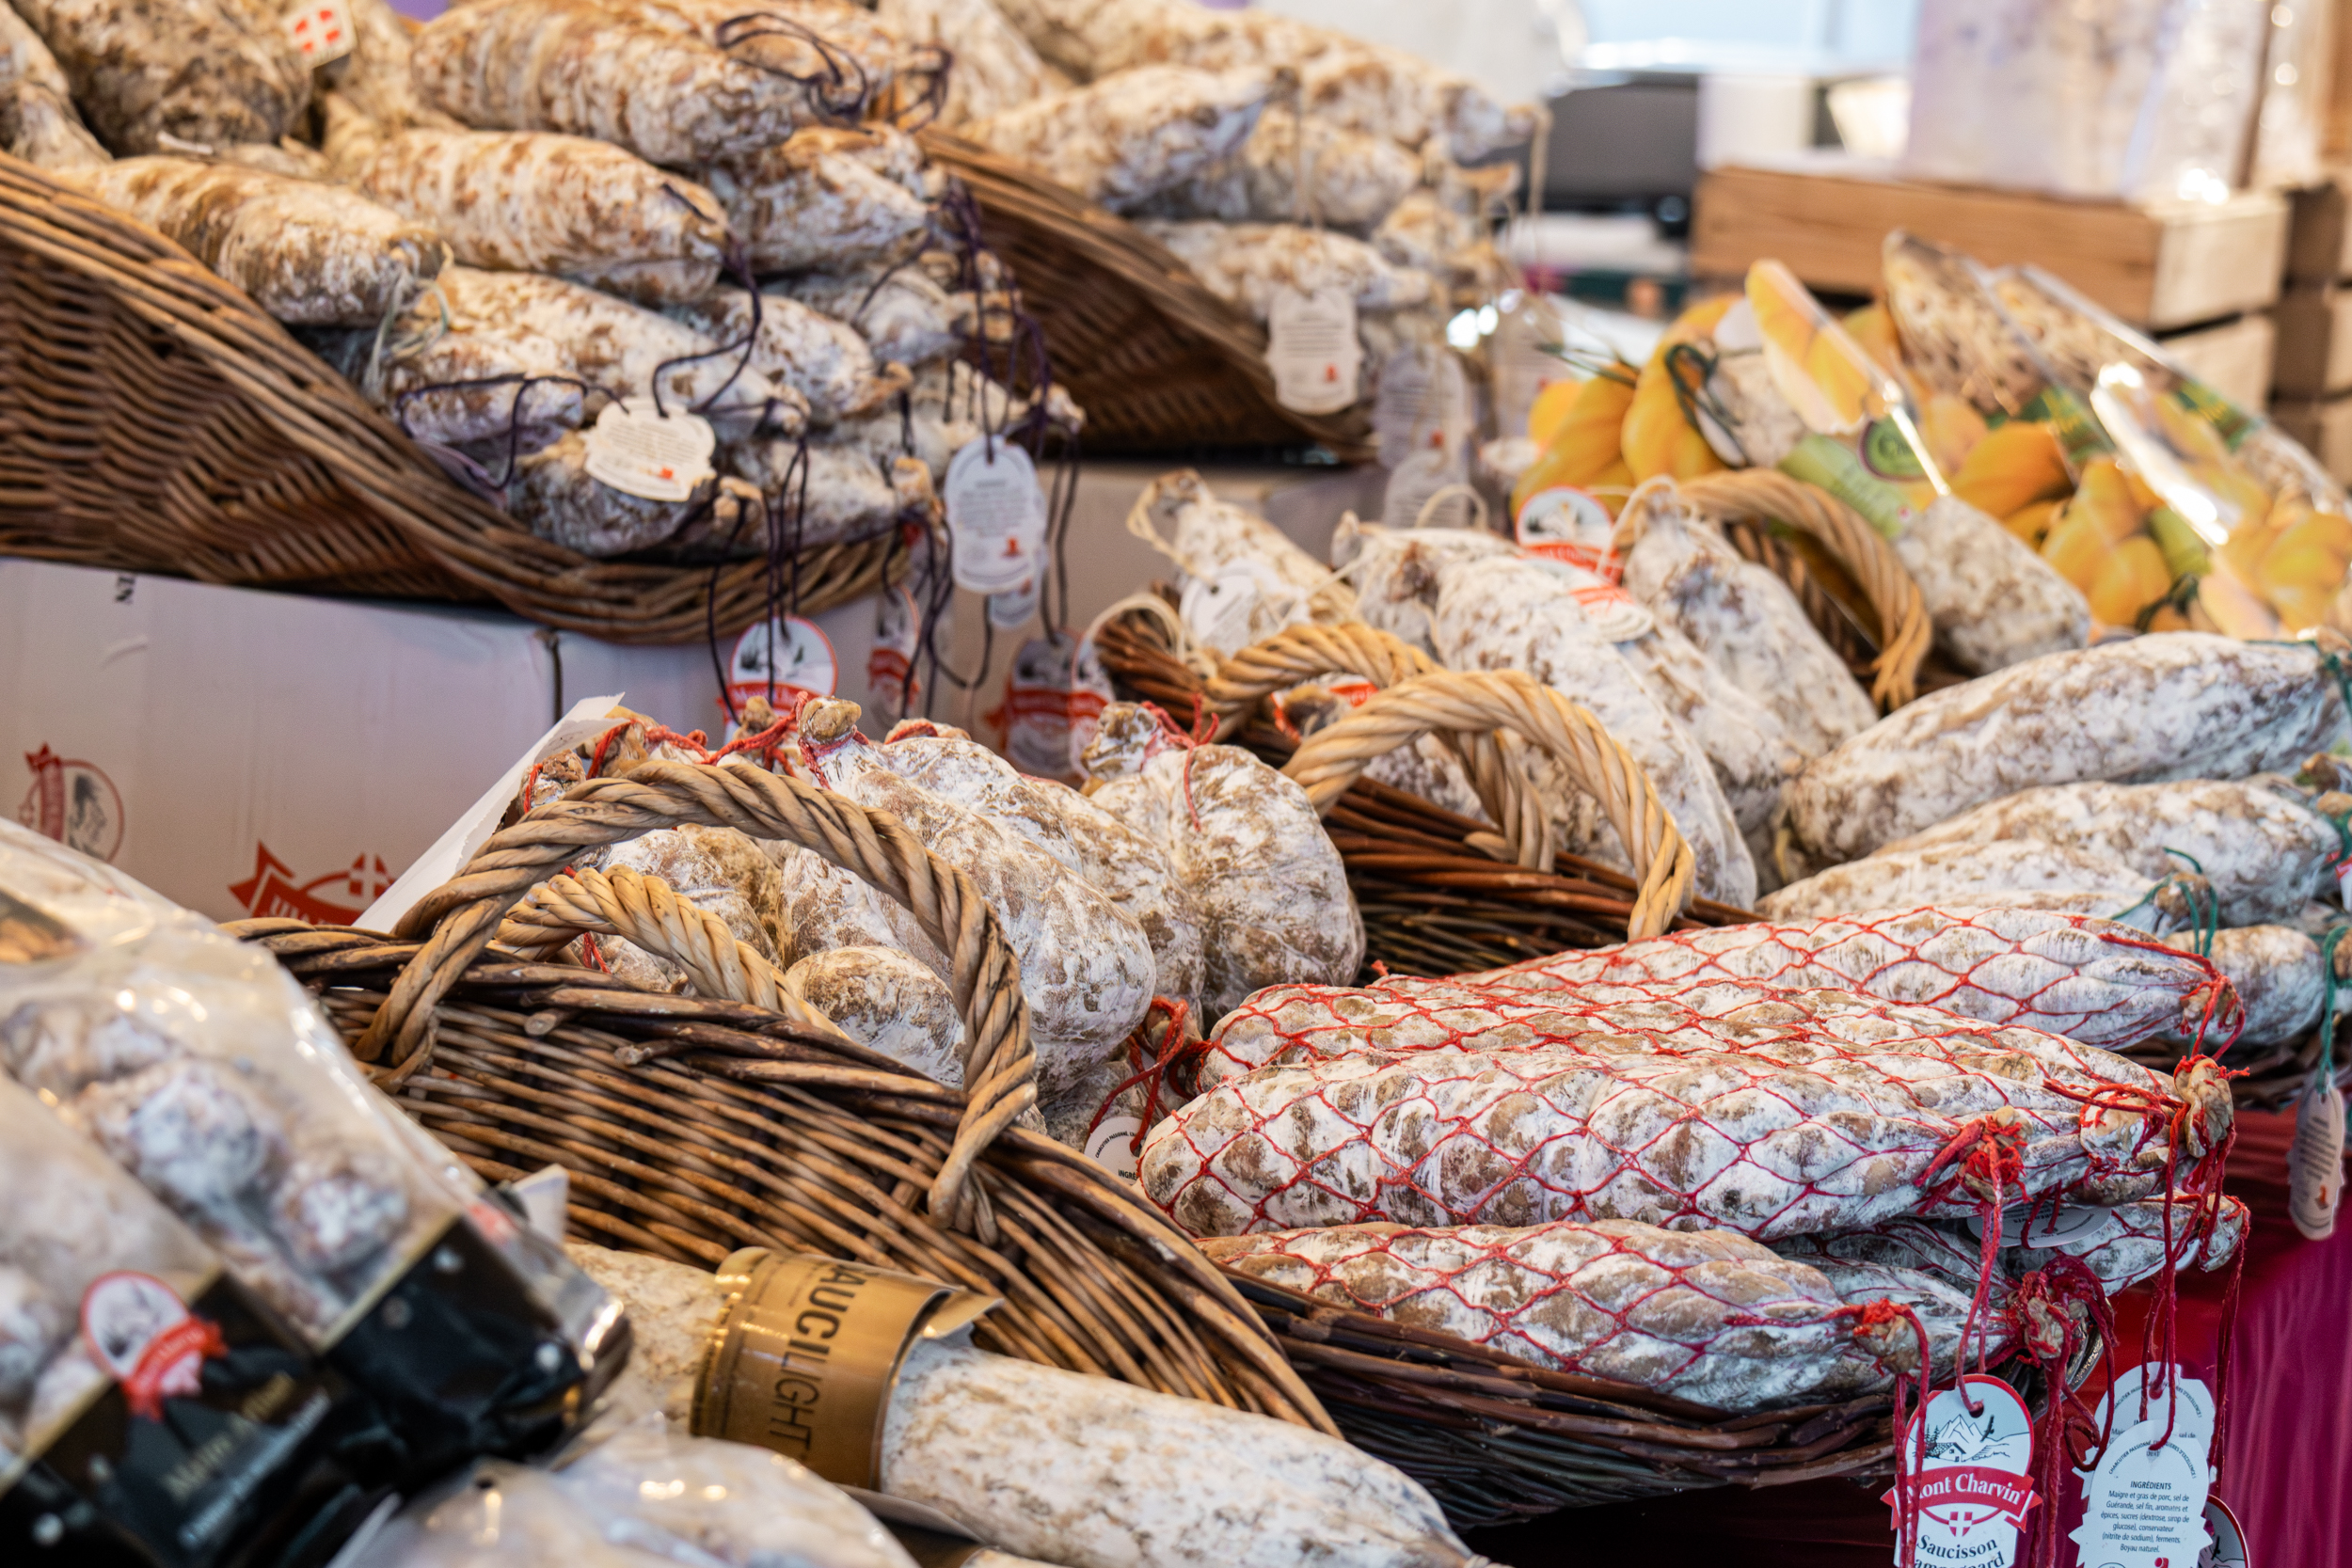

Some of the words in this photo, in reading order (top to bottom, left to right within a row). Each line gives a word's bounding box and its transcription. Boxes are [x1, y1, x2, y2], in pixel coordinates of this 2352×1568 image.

[768, 1262, 871, 1452] AUCILIGHT
[2108, 1450, 2130, 1475] CHARCUTIER
[1955, 1473, 2022, 1505] Charvin
[2130, 1481, 2171, 1490] INGRÉDIENTS
[2108, 1490, 2128, 1499] Maigre
[2173, 1494, 2182, 1502] sel
[2182, 1494, 2189, 1502] de
[2106, 1500, 2135, 1510] Guérande,
[2101, 1511, 2119, 1520] épices,
[2167, 1515, 2181, 1524] sirop
[2102, 1531, 2122, 1541] (nitrite
[2130, 1534, 2154, 1543] sodium),
[1916, 1534, 1997, 1559] Saucisson
[2120, 1543, 2137, 1553] Boyau
[2137, 1544, 2160, 1553] naturel.
